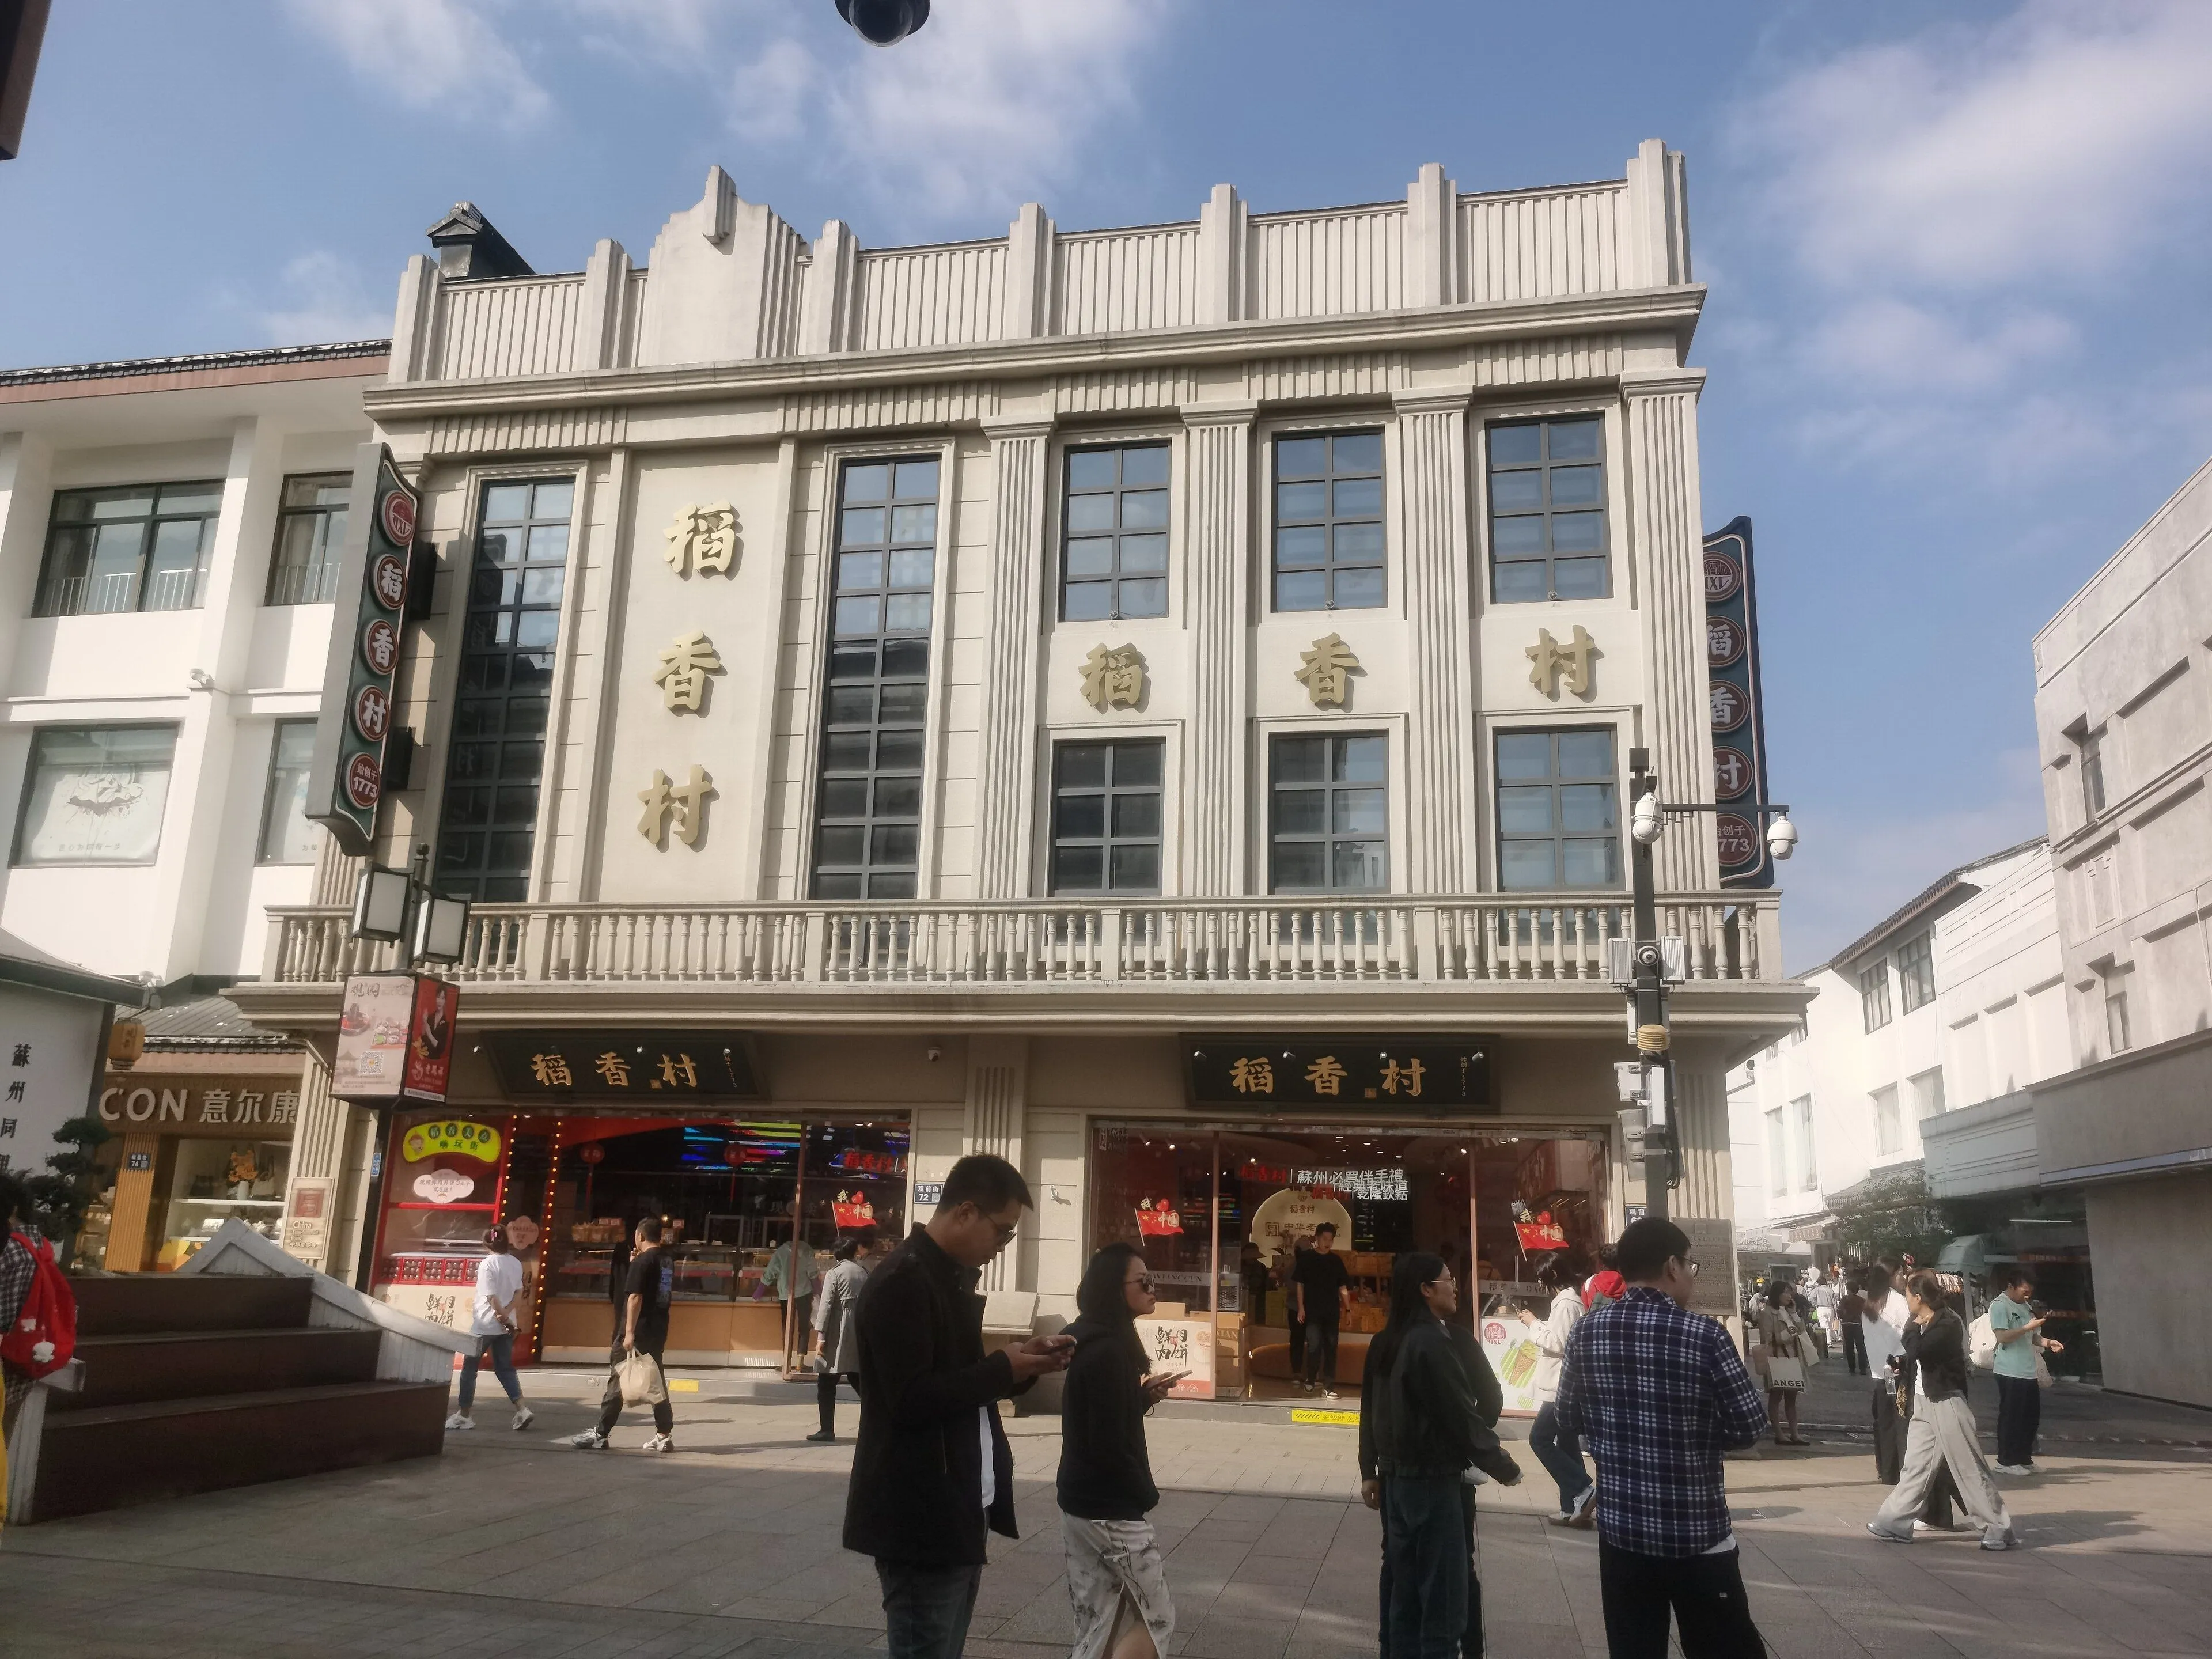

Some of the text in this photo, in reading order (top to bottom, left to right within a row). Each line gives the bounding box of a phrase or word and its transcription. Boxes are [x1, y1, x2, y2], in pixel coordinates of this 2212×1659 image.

[363, 563, 403, 734] 稻香村
[637, 499, 737, 846] 稻香村
[1078, 624, 1597, 706] 稻香村
[356, 762, 377, 780] 始创于
[353, 777, 378, 798] 1773
[530, 1051, 698, 1088] 稻香村
[1229, 1055, 1426, 1096] 稻香村
[99, 1088, 188, 1122] CON
[199, 1089, 299, 1124] 意尔康
[837, 1189, 849, 1204] 我
[1140, 1196, 1153, 1211] 我
[853, 1203, 873, 1219] 中国
[1290, 1205, 1315, 1214] 稻香村
[1520, 1208, 1535, 1225] 我
[293, 1221, 312, 1229] China
[1158, 1211, 1179, 1228] 中国
[1540, 1224, 1563, 1242] 中国
